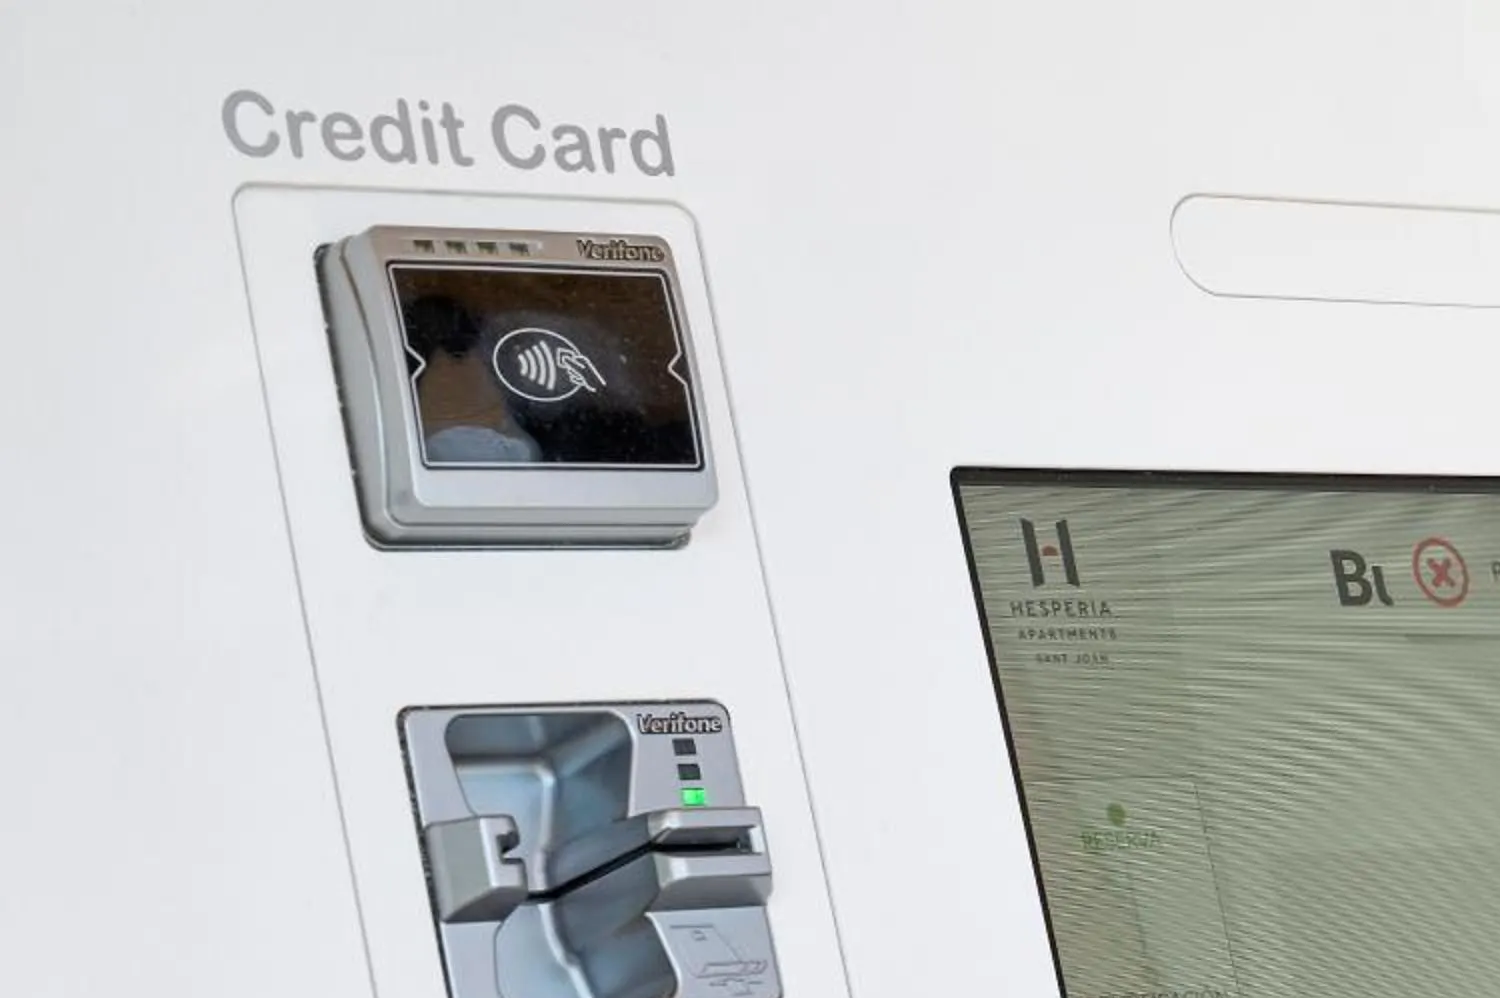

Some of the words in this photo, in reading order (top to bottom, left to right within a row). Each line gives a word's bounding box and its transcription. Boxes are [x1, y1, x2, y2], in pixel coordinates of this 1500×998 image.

[221, 89, 474, 167] Credit
[491, 103, 676, 177] Card
[576, 237, 666, 263] Verifone
[1009, 600, 1113, 618] HESPERIA
[636, 712, 723, 735] Verifone
